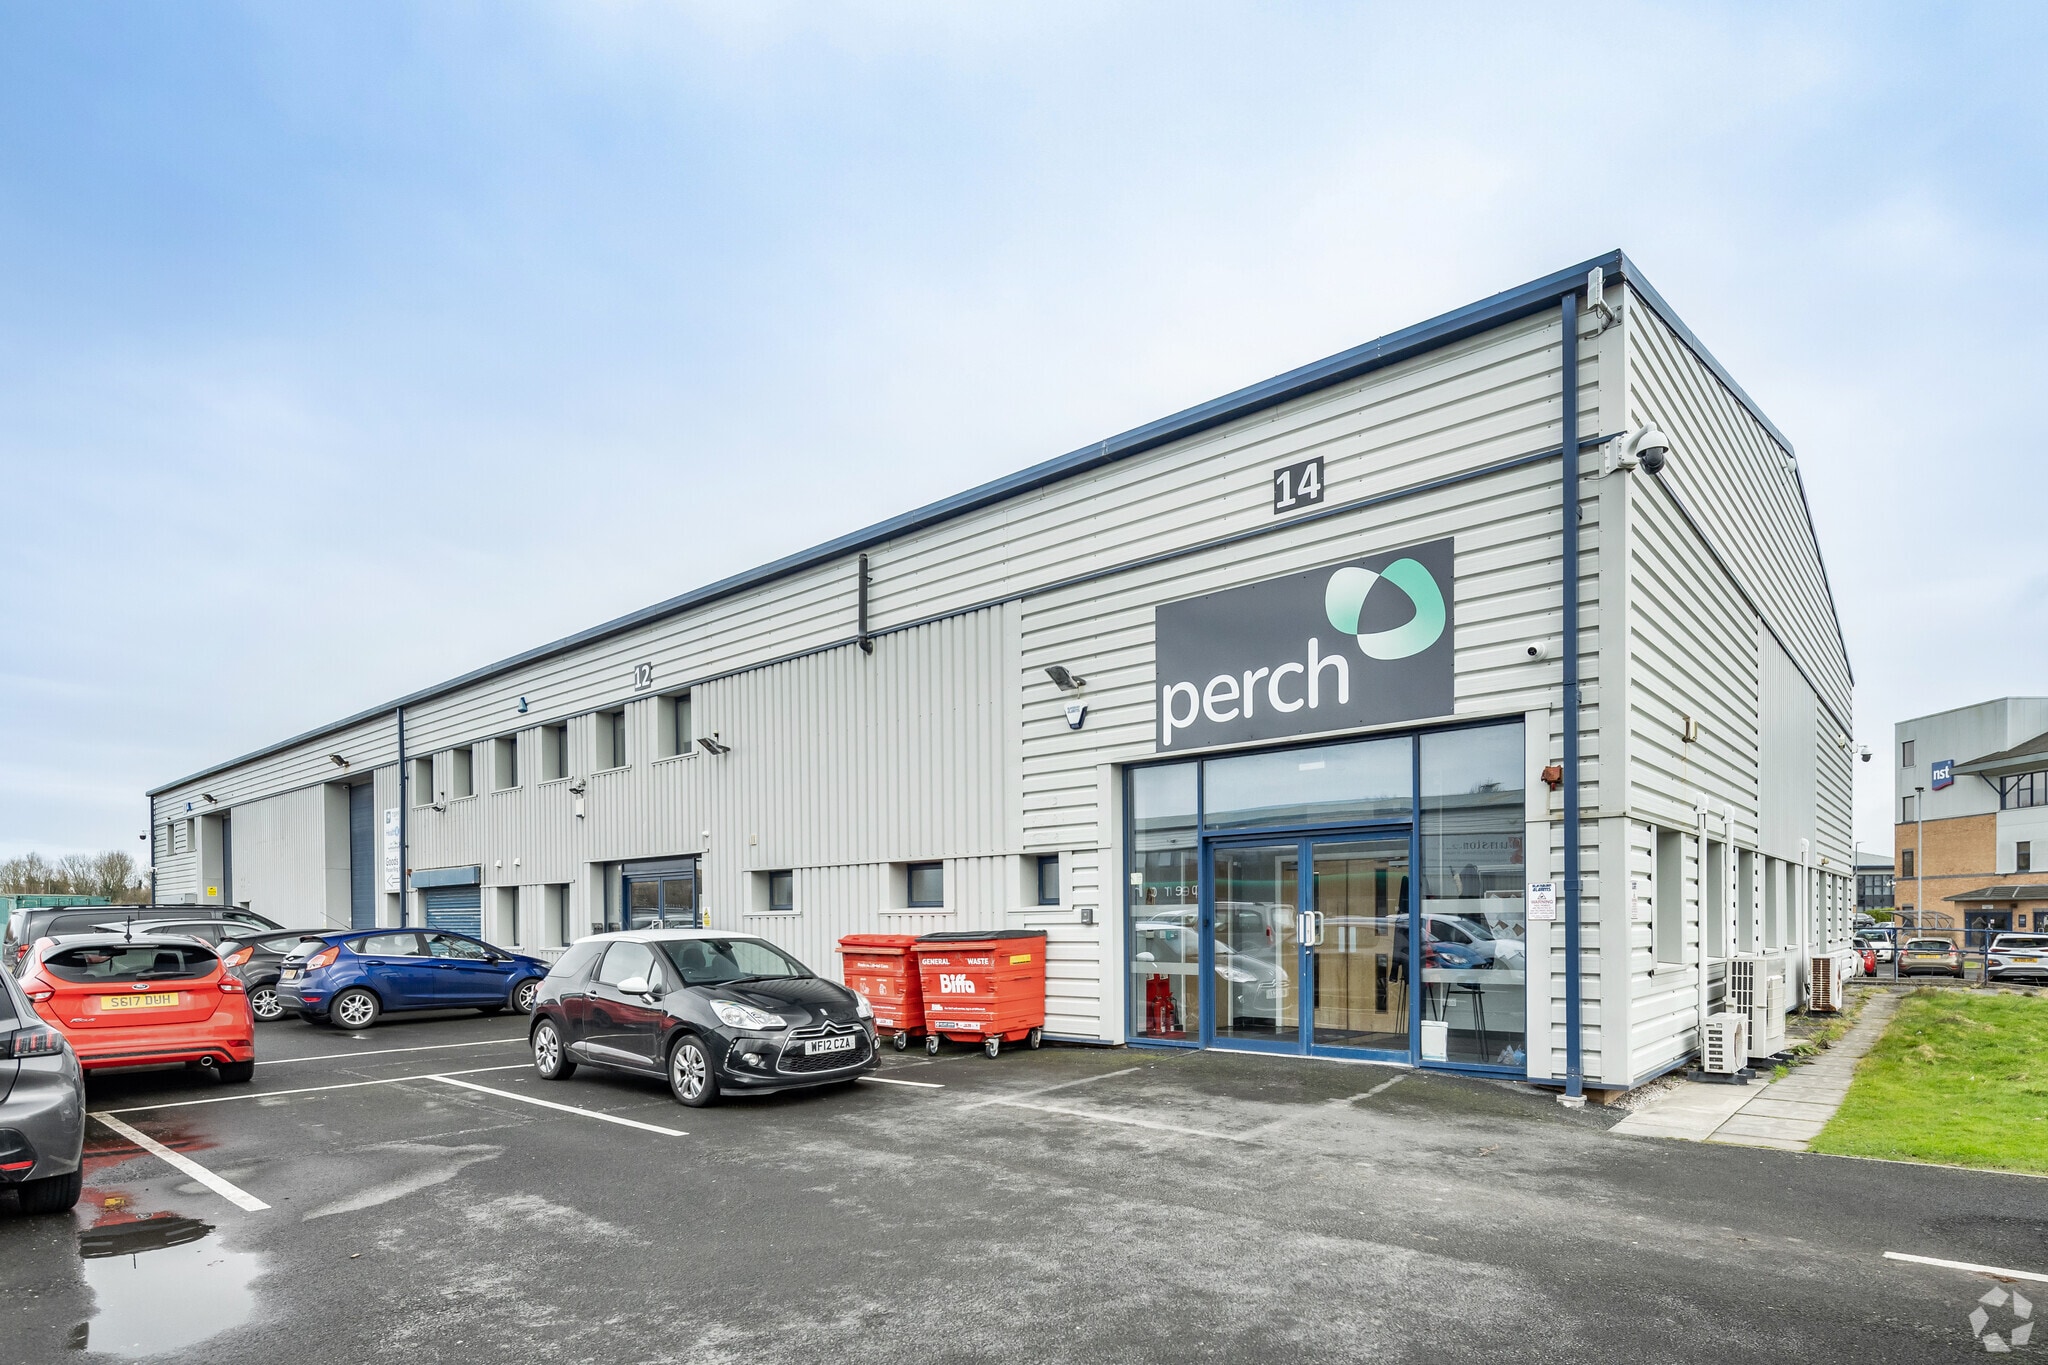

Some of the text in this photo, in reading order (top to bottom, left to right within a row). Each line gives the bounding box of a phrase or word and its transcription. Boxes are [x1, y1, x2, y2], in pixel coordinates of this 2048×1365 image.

[1276, 462, 1321, 509] 14
[634, 664, 651, 689] 12
[1163, 637, 1350, 746] perch
[1933, 765, 1950, 780] nst
[922, 958, 989, 966] GENERAL WASTE
[939, 973, 976, 994] Biffa
[811, 1037, 850, 1052] WF12 CZA
